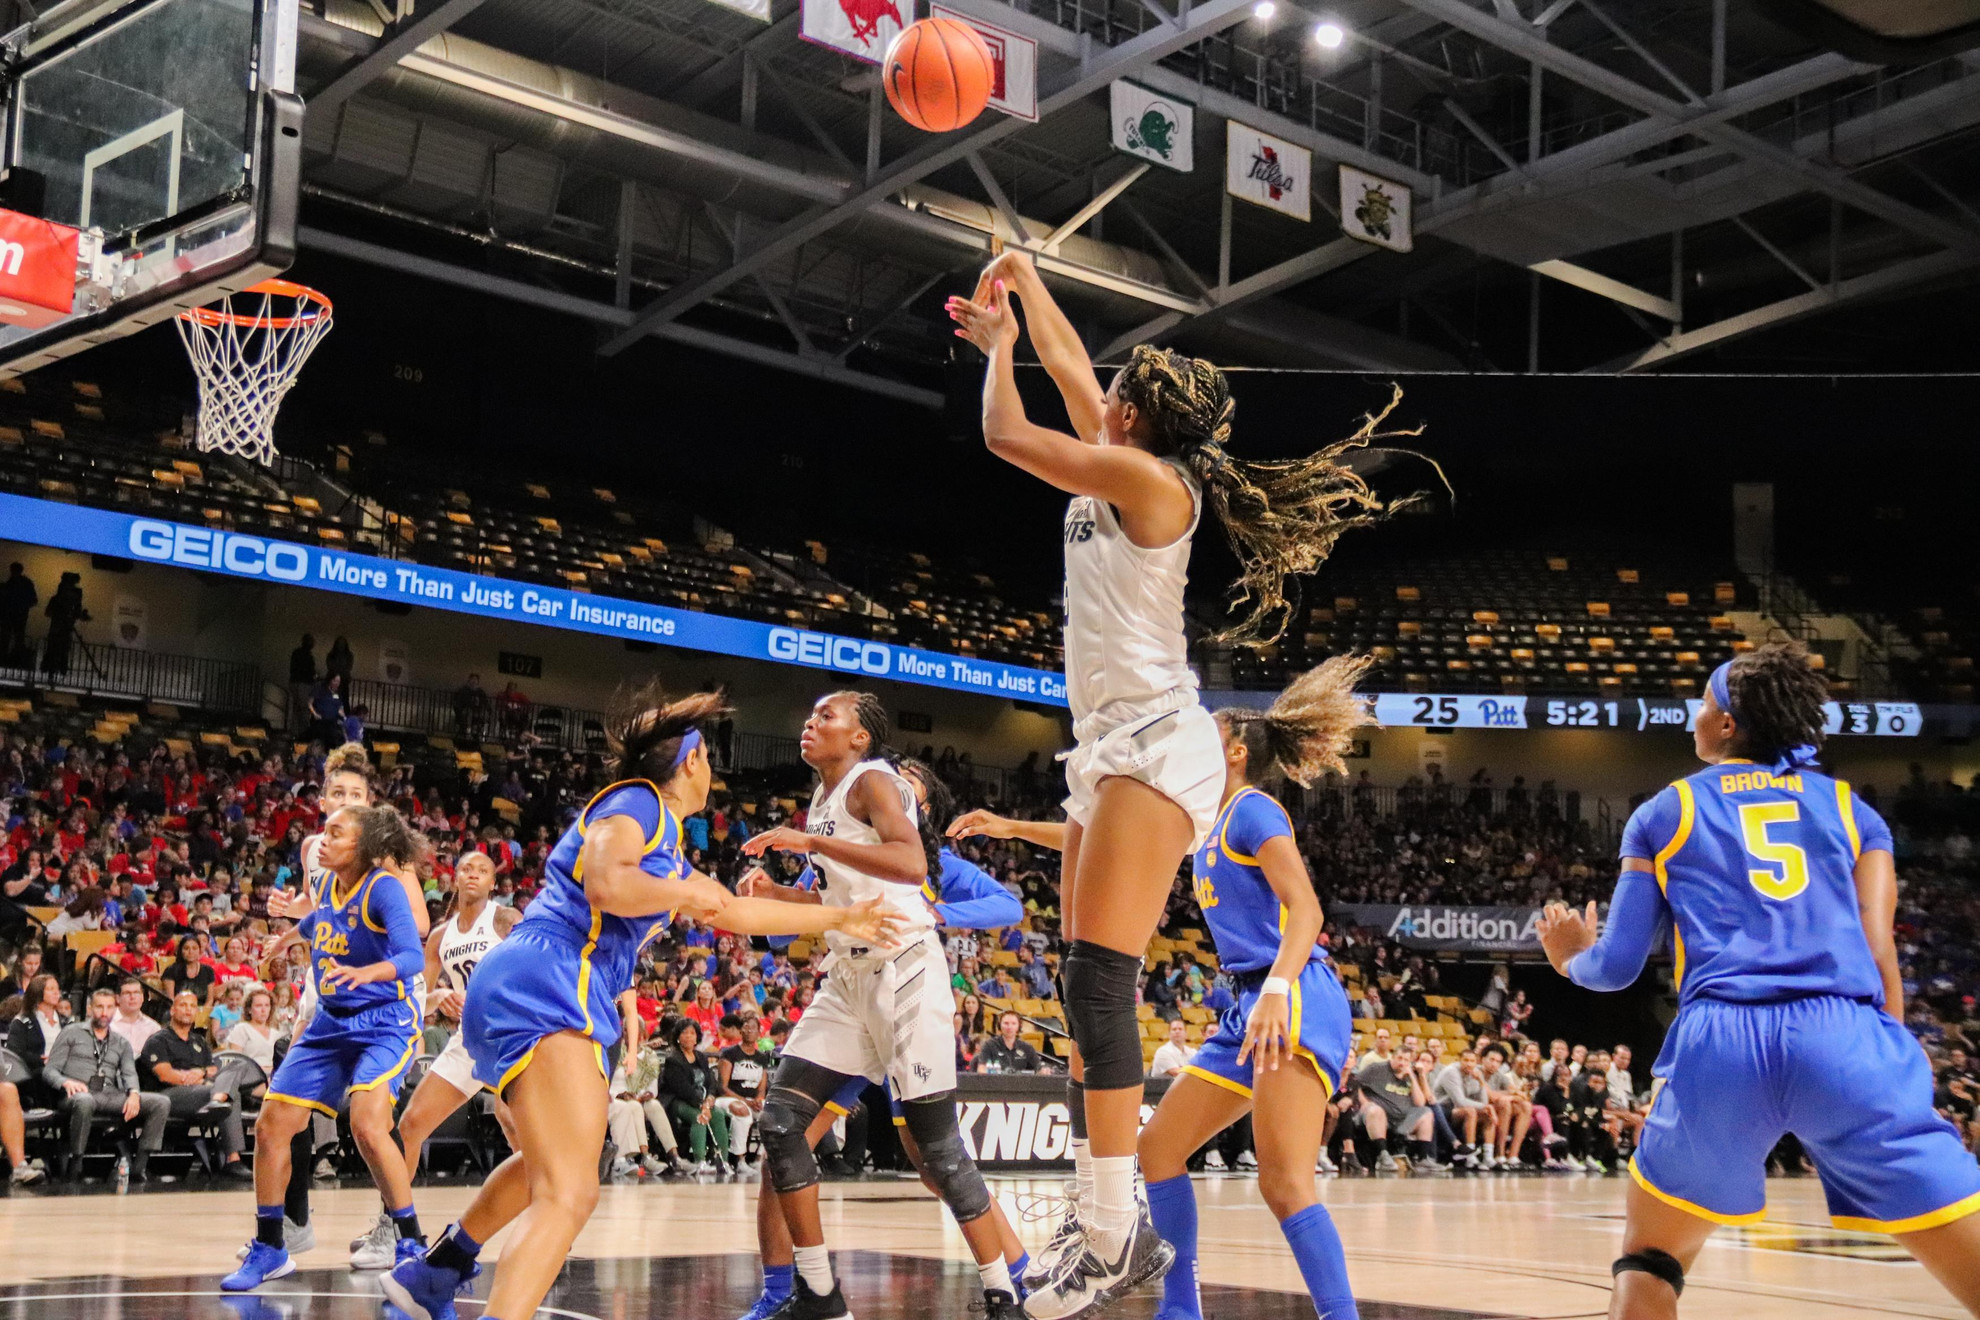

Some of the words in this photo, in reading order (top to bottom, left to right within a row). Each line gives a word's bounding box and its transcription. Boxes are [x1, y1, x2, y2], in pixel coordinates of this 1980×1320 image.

[1248, 154, 1294, 192] Tulsa
[393, 364, 423, 382] 209
[129, 519, 308, 581] GEICO
[319, 554, 388, 589] More
[396, 568, 453, 600] Than
[461, 580, 514, 610] Just
[521, 590, 564, 617] Car
[570, 598, 675, 636] Insurance
[768, 628, 891, 675] GEICO
[898, 652, 946, 680] More
[951, 661, 993, 687] Than
[997, 670, 1036, 694] Just
[1040, 677, 1067, 699] Car
[1412, 697, 1459, 725] 25
[1478, 699, 1518, 726] Pitt
[1546, 700, 1618, 726] 5:21
[1649, 708, 1686, 724] 2ND
[1850, 713, 1869, 734] 3
[1890, 715, 1905, 733] 0
[1720, 771, 1805, 794] BROWN
[1738, 801, 1810, 901] 5
[1387, 907, 1518, 941] Addition
[314, 921, 351, 956] Pitt
[443, 941, 489, 962] KNIGHTS
[318, 957, 337, 996] 2
[911, 1062, 933, 1083] UCF
